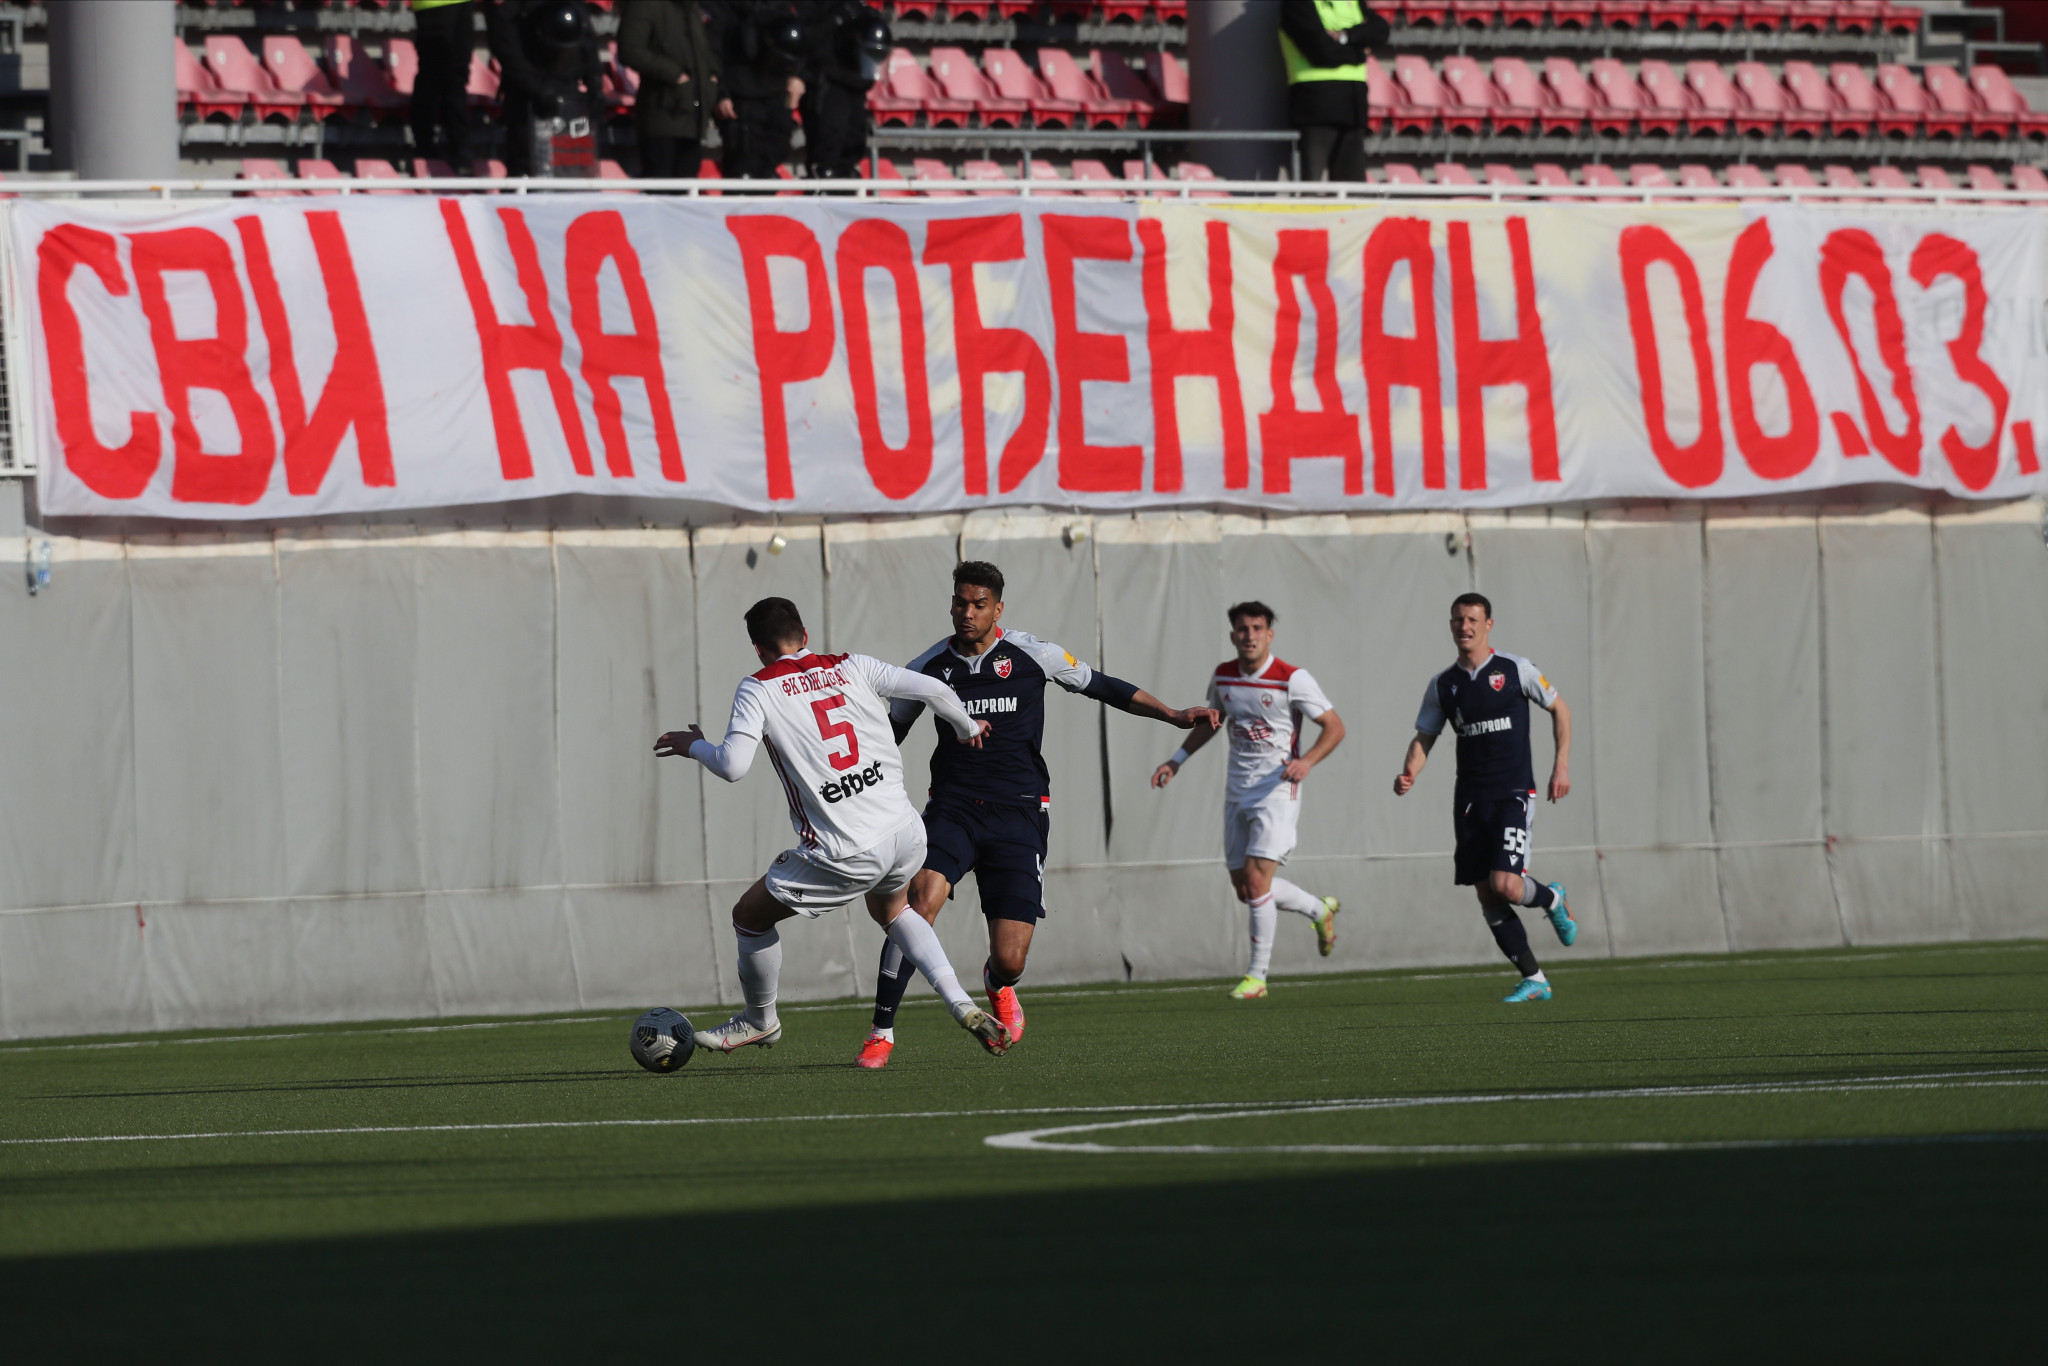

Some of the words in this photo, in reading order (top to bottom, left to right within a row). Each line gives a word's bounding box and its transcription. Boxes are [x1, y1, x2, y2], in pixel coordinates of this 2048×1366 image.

[37, 211, 396, 505] СВИ
[439, 199, 687, 483] НА
[726, 213, 1561, 501] РОЂЕНДАН
[1618, 216, 2040, 492] 06.03.
[782, 676, 801, 697] ФК
[810, 693, 860, 772] 5
[821, 760, 884, 804] efbet
[1503, 826, 1526, 855] 55
